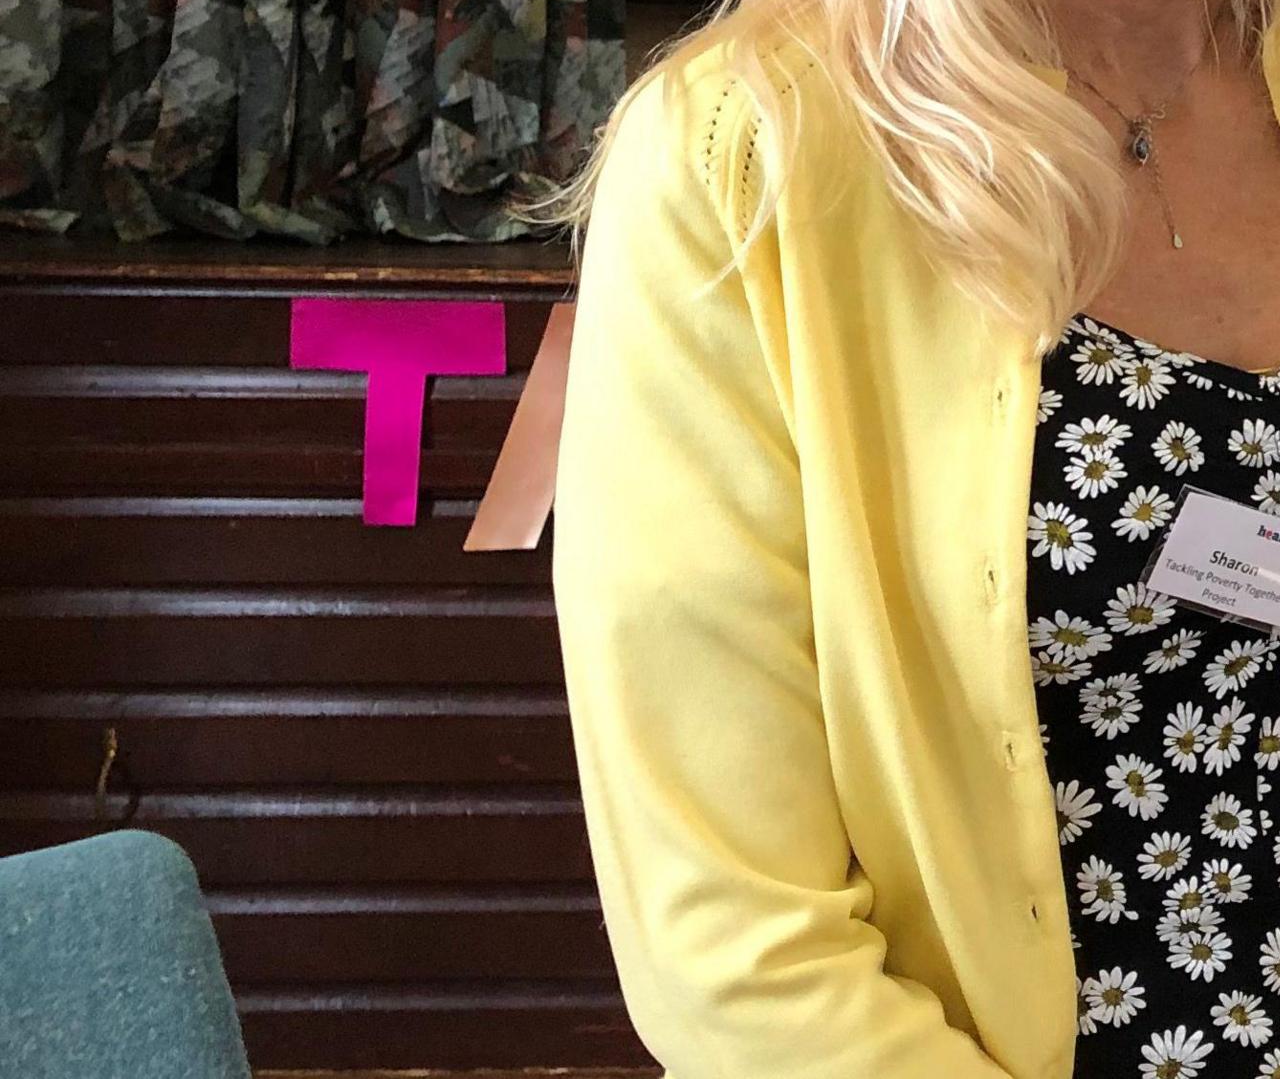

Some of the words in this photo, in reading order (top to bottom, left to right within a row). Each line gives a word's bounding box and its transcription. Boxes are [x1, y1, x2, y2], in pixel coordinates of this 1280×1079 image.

[1165, 558, 1205, 581] Tackling
[1205, 571, 1243, 592] Poverty
[1209, 550, 1259, 577] Sharon
[1201, 588, 1237, 608] Project
